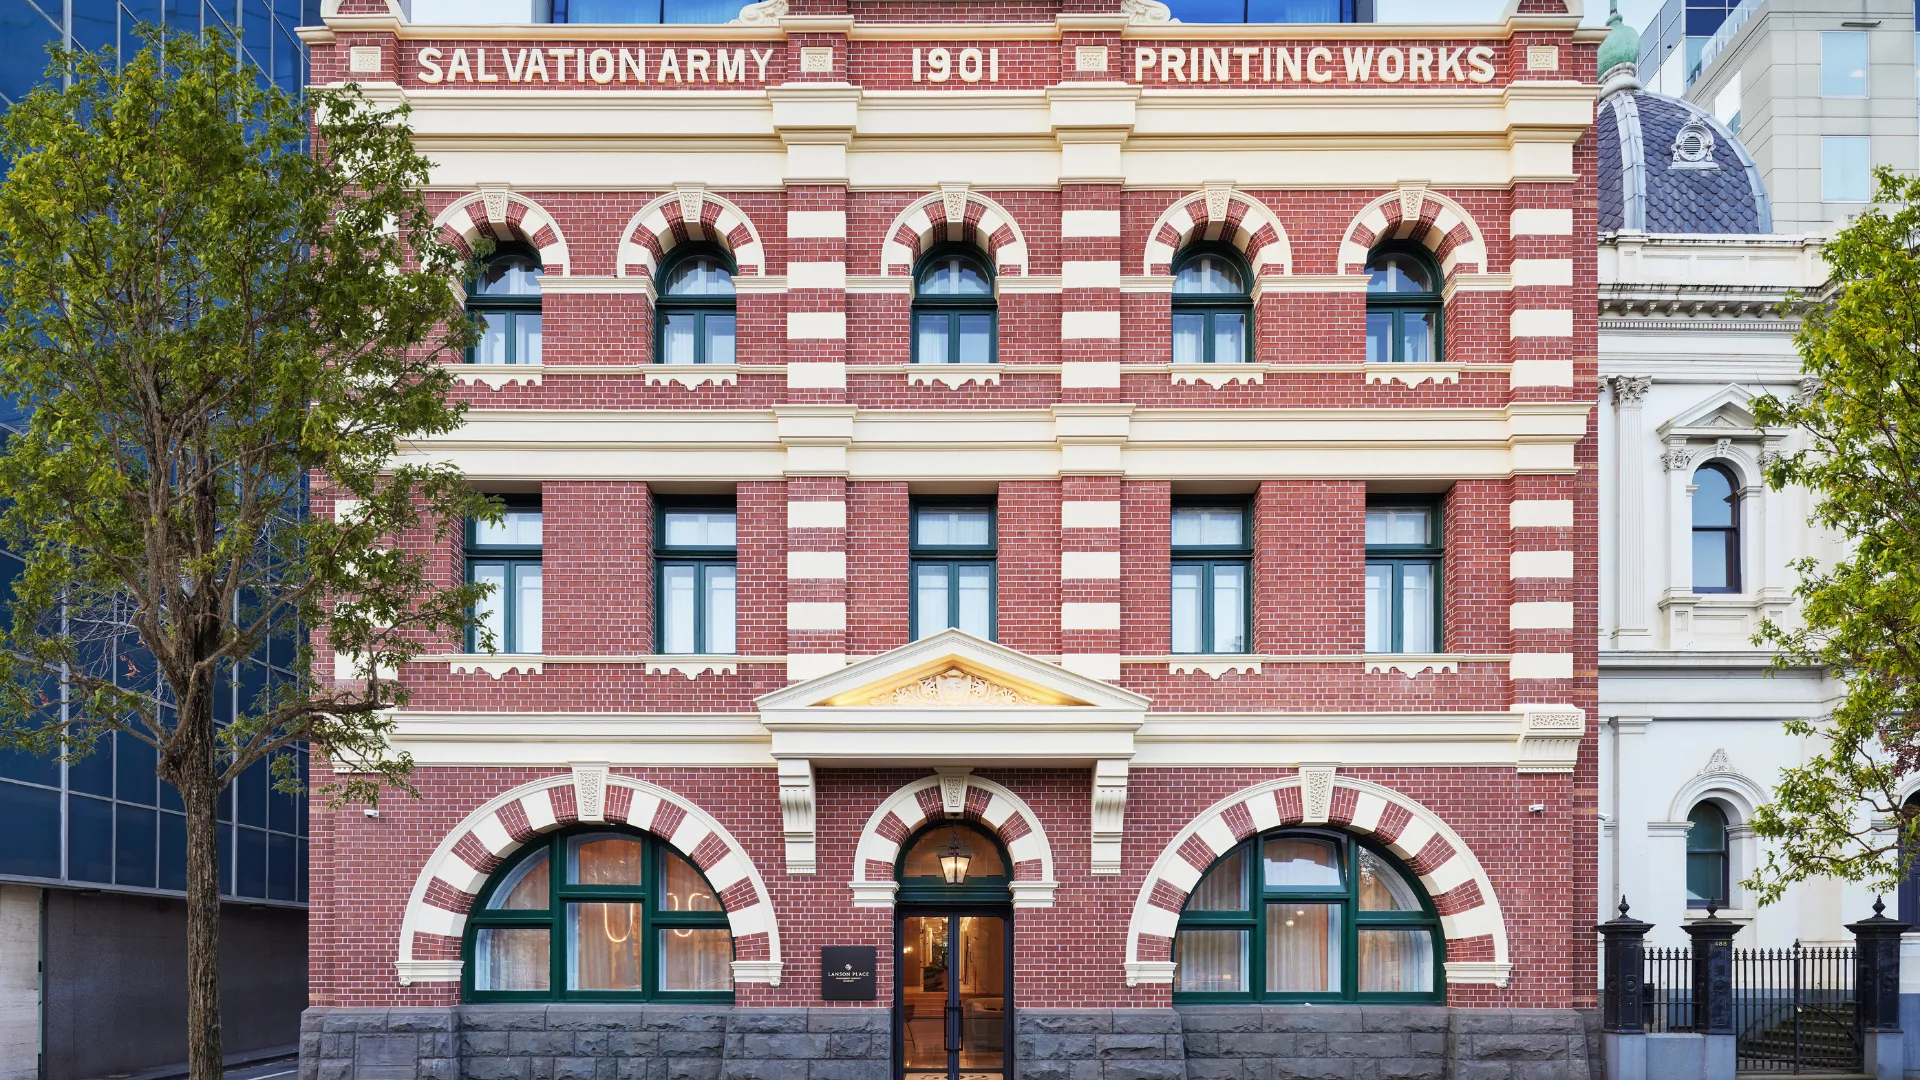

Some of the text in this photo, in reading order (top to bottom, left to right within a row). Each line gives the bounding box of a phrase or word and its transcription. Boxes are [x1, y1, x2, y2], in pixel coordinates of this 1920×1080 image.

[417, 47, 774, 84] SALVATION ARMY
[912, 47, 999, 83] 1901
[1135, 46, 1496, 83] PRINTING WORKS
